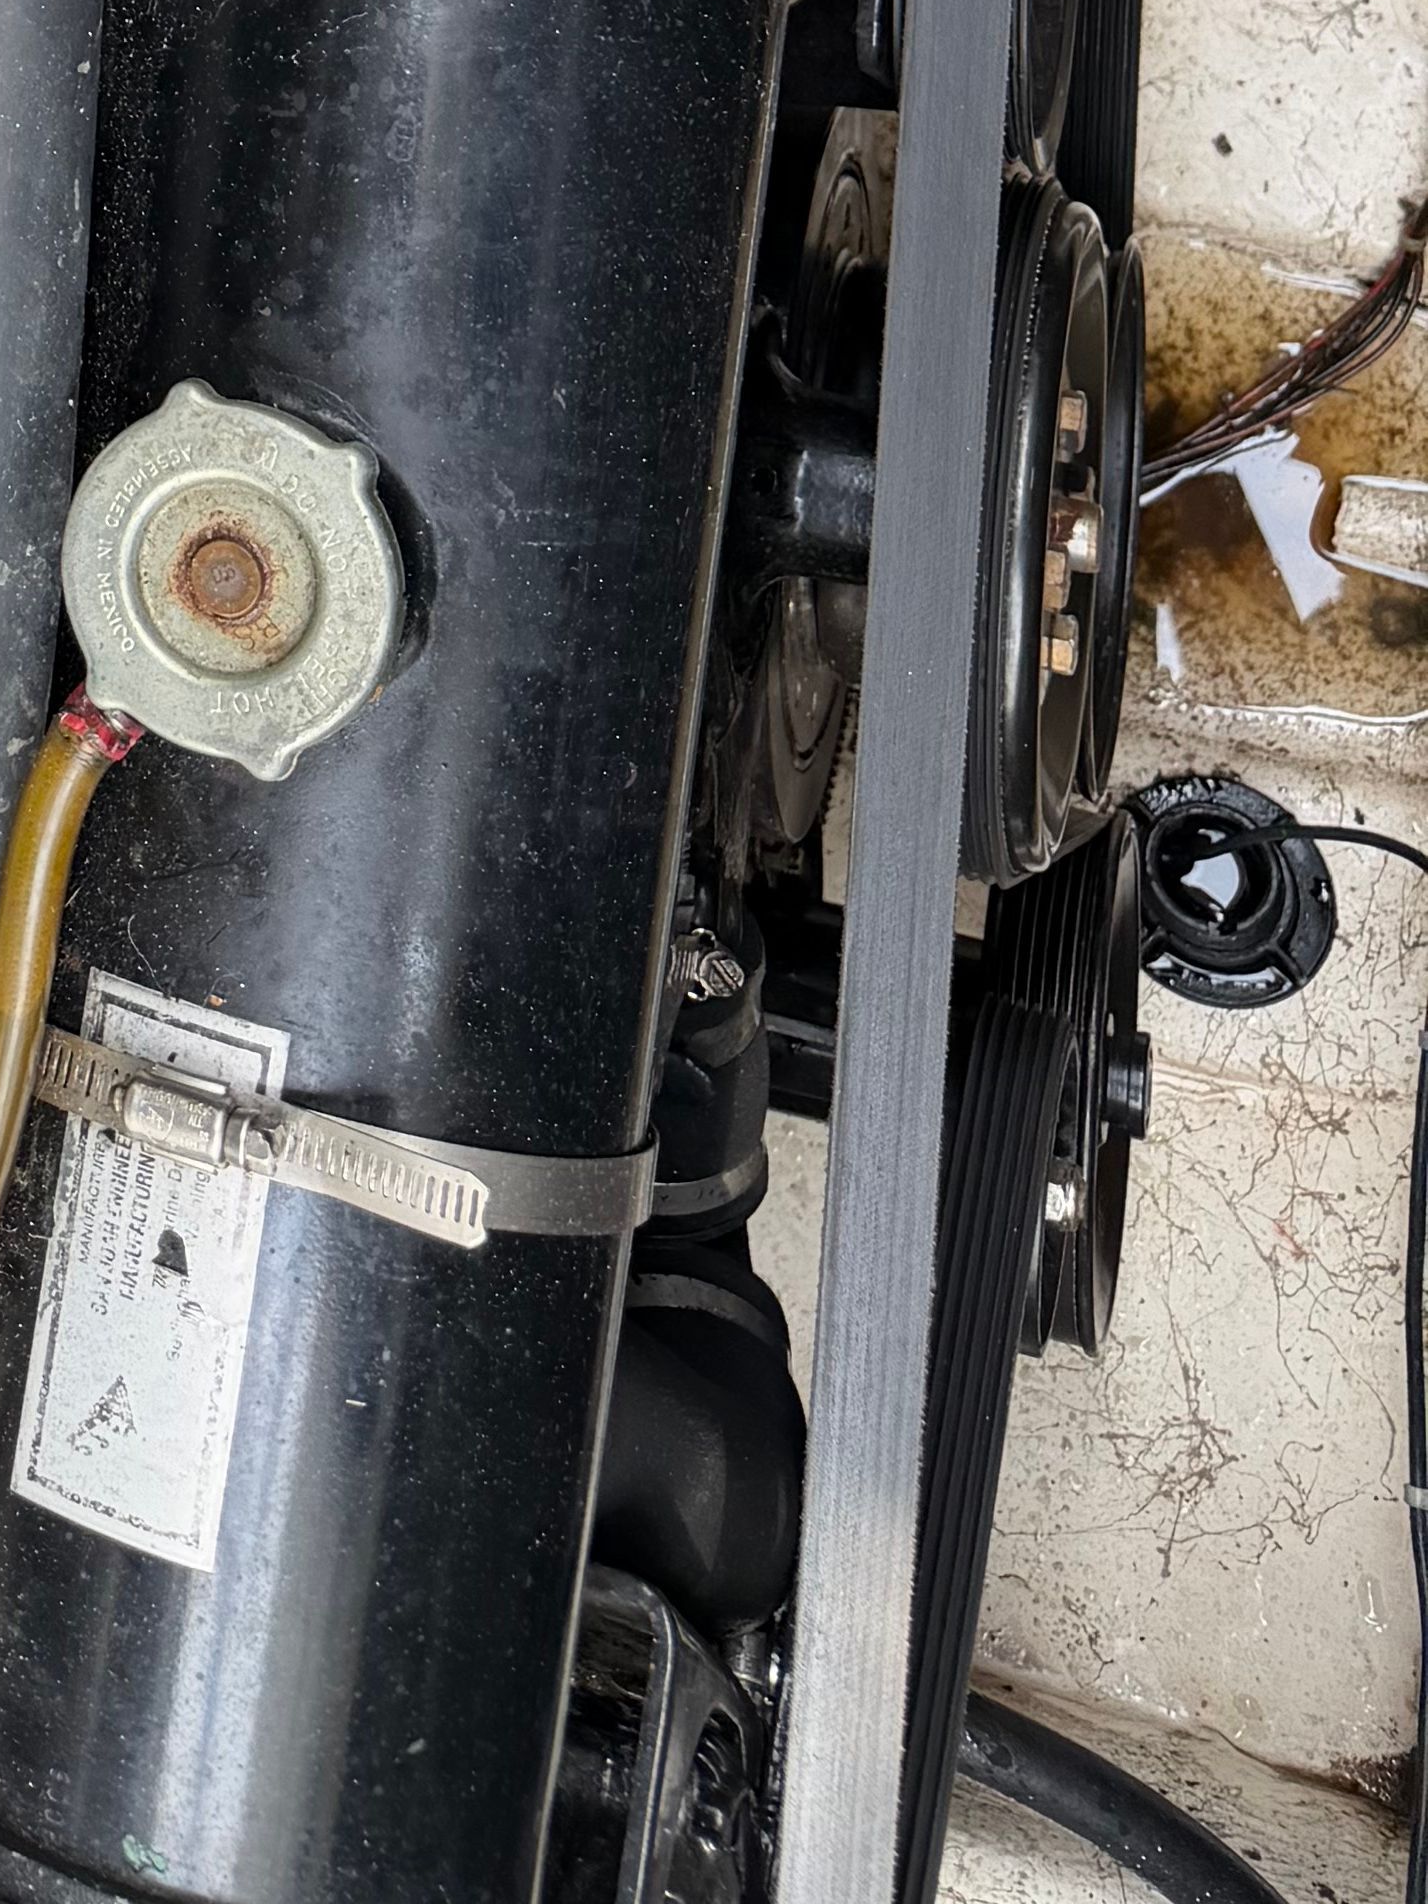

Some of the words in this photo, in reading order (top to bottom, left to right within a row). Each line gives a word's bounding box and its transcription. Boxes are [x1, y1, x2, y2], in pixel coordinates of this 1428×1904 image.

[104, 441, 194, 529] ASSEMBLED
[96, 537, 114, 560] IN
[96, 571, 135, 653] MEXICO
[208, 685, 275, 715] HOT
